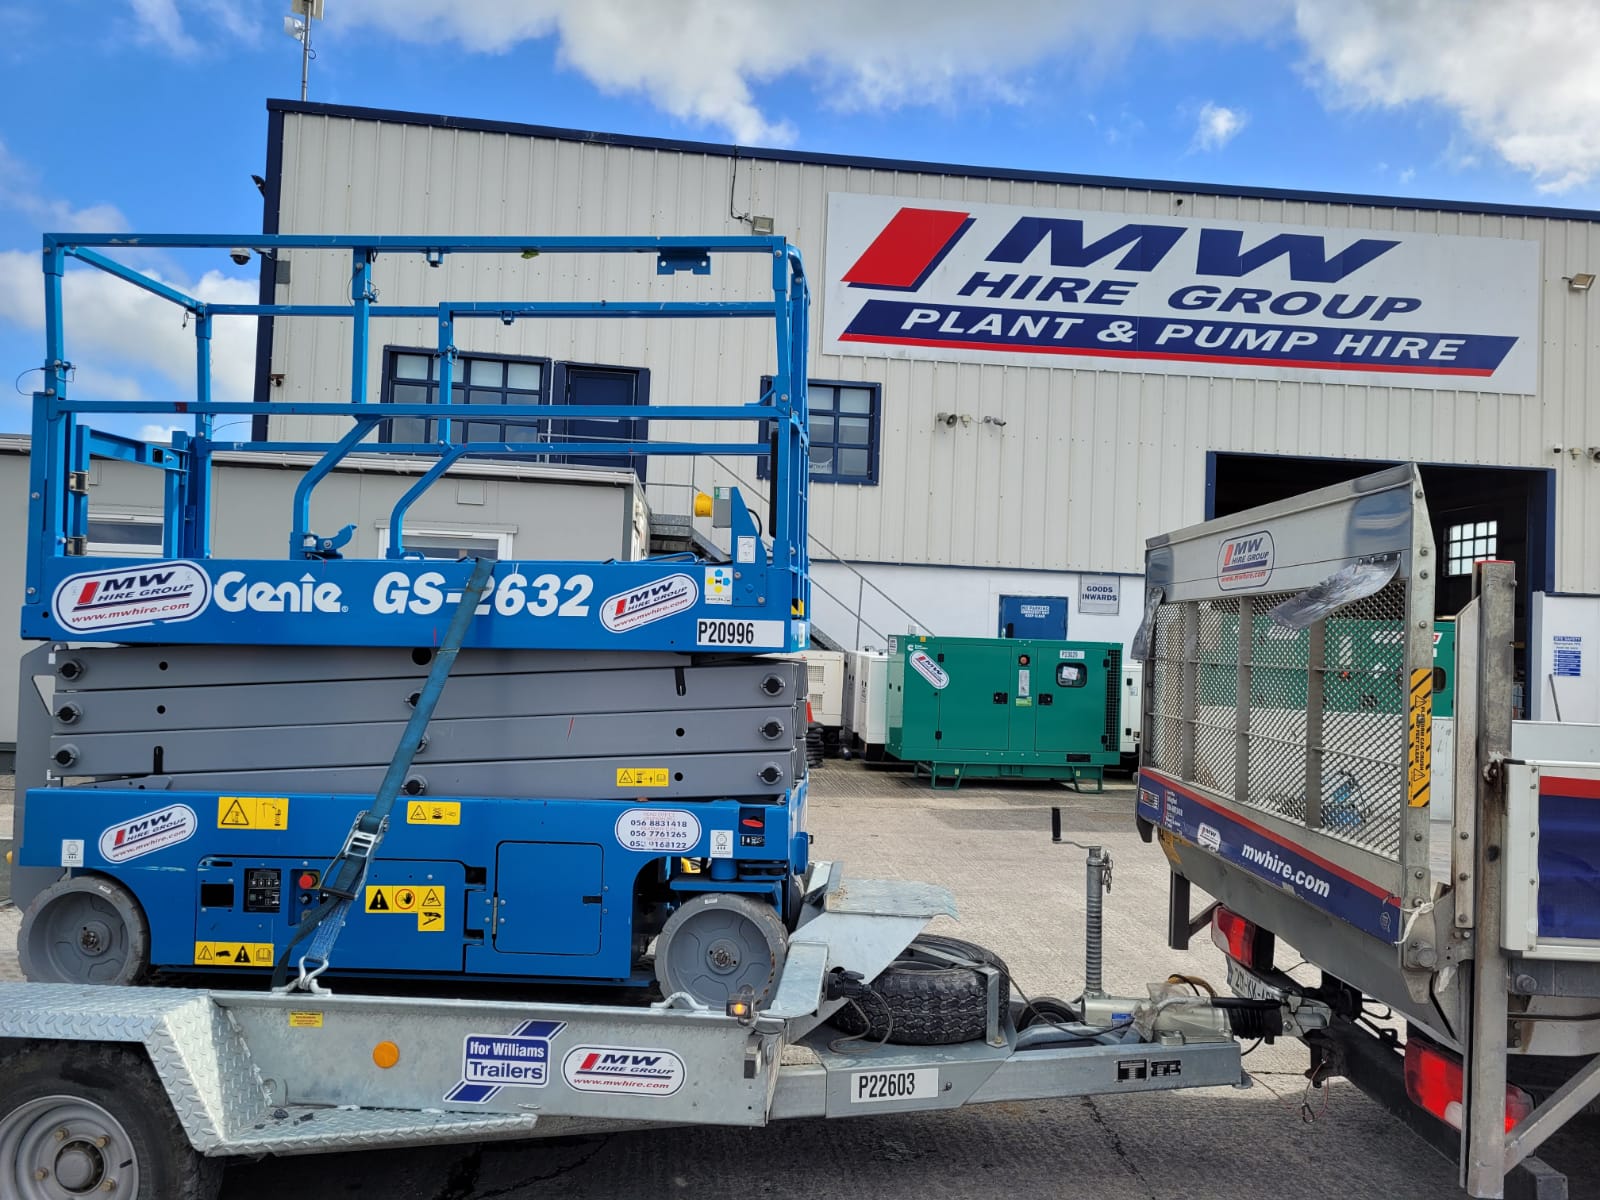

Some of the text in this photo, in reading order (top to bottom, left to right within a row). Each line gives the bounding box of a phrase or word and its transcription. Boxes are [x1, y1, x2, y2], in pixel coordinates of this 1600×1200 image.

[984, 216, 1403, 284] MW
[957, 271, 1423, 321] HIRE GROUP
[900, 308, 1466, 361] PLANT & PUMP HIRE
[1233, 537, 1264, 556] MW
[1231, 551, 1270, 564] HIRE GROUP
[102, 571, 176, 592] MW
[213, 571, 343, 613] Genie
[1086, 585, 1113, 593] GOODS
[97, 583, 194, 602] HIRE GROUP
[627, 586, 688, 611] HIRE GROUP
[629, 581, 674, 604] MW
[1082, 593, 1118, 602] INWARDS
[71, 602, 190, 623] www.mwhire.com
[698, 621, 754, 645] P20996
[127, 817, 186, 841] HIRE GROUP
[129, 812, 173, 835] MW
[649, 820, 687, 828] 8831418
[1241, 843, 1330, 898] mwhire.com
[469, 1041, 545, 1058] Ifor Williams
[469, 1061, 543, 1080] Trailers
[601, 1054, 662, 1067] MW
[630, 1067, 675, 1075] GROUP
[573, 1078, 670, 1090] www.mwhire.com
[858, 1072, 916, 1099] P22603
